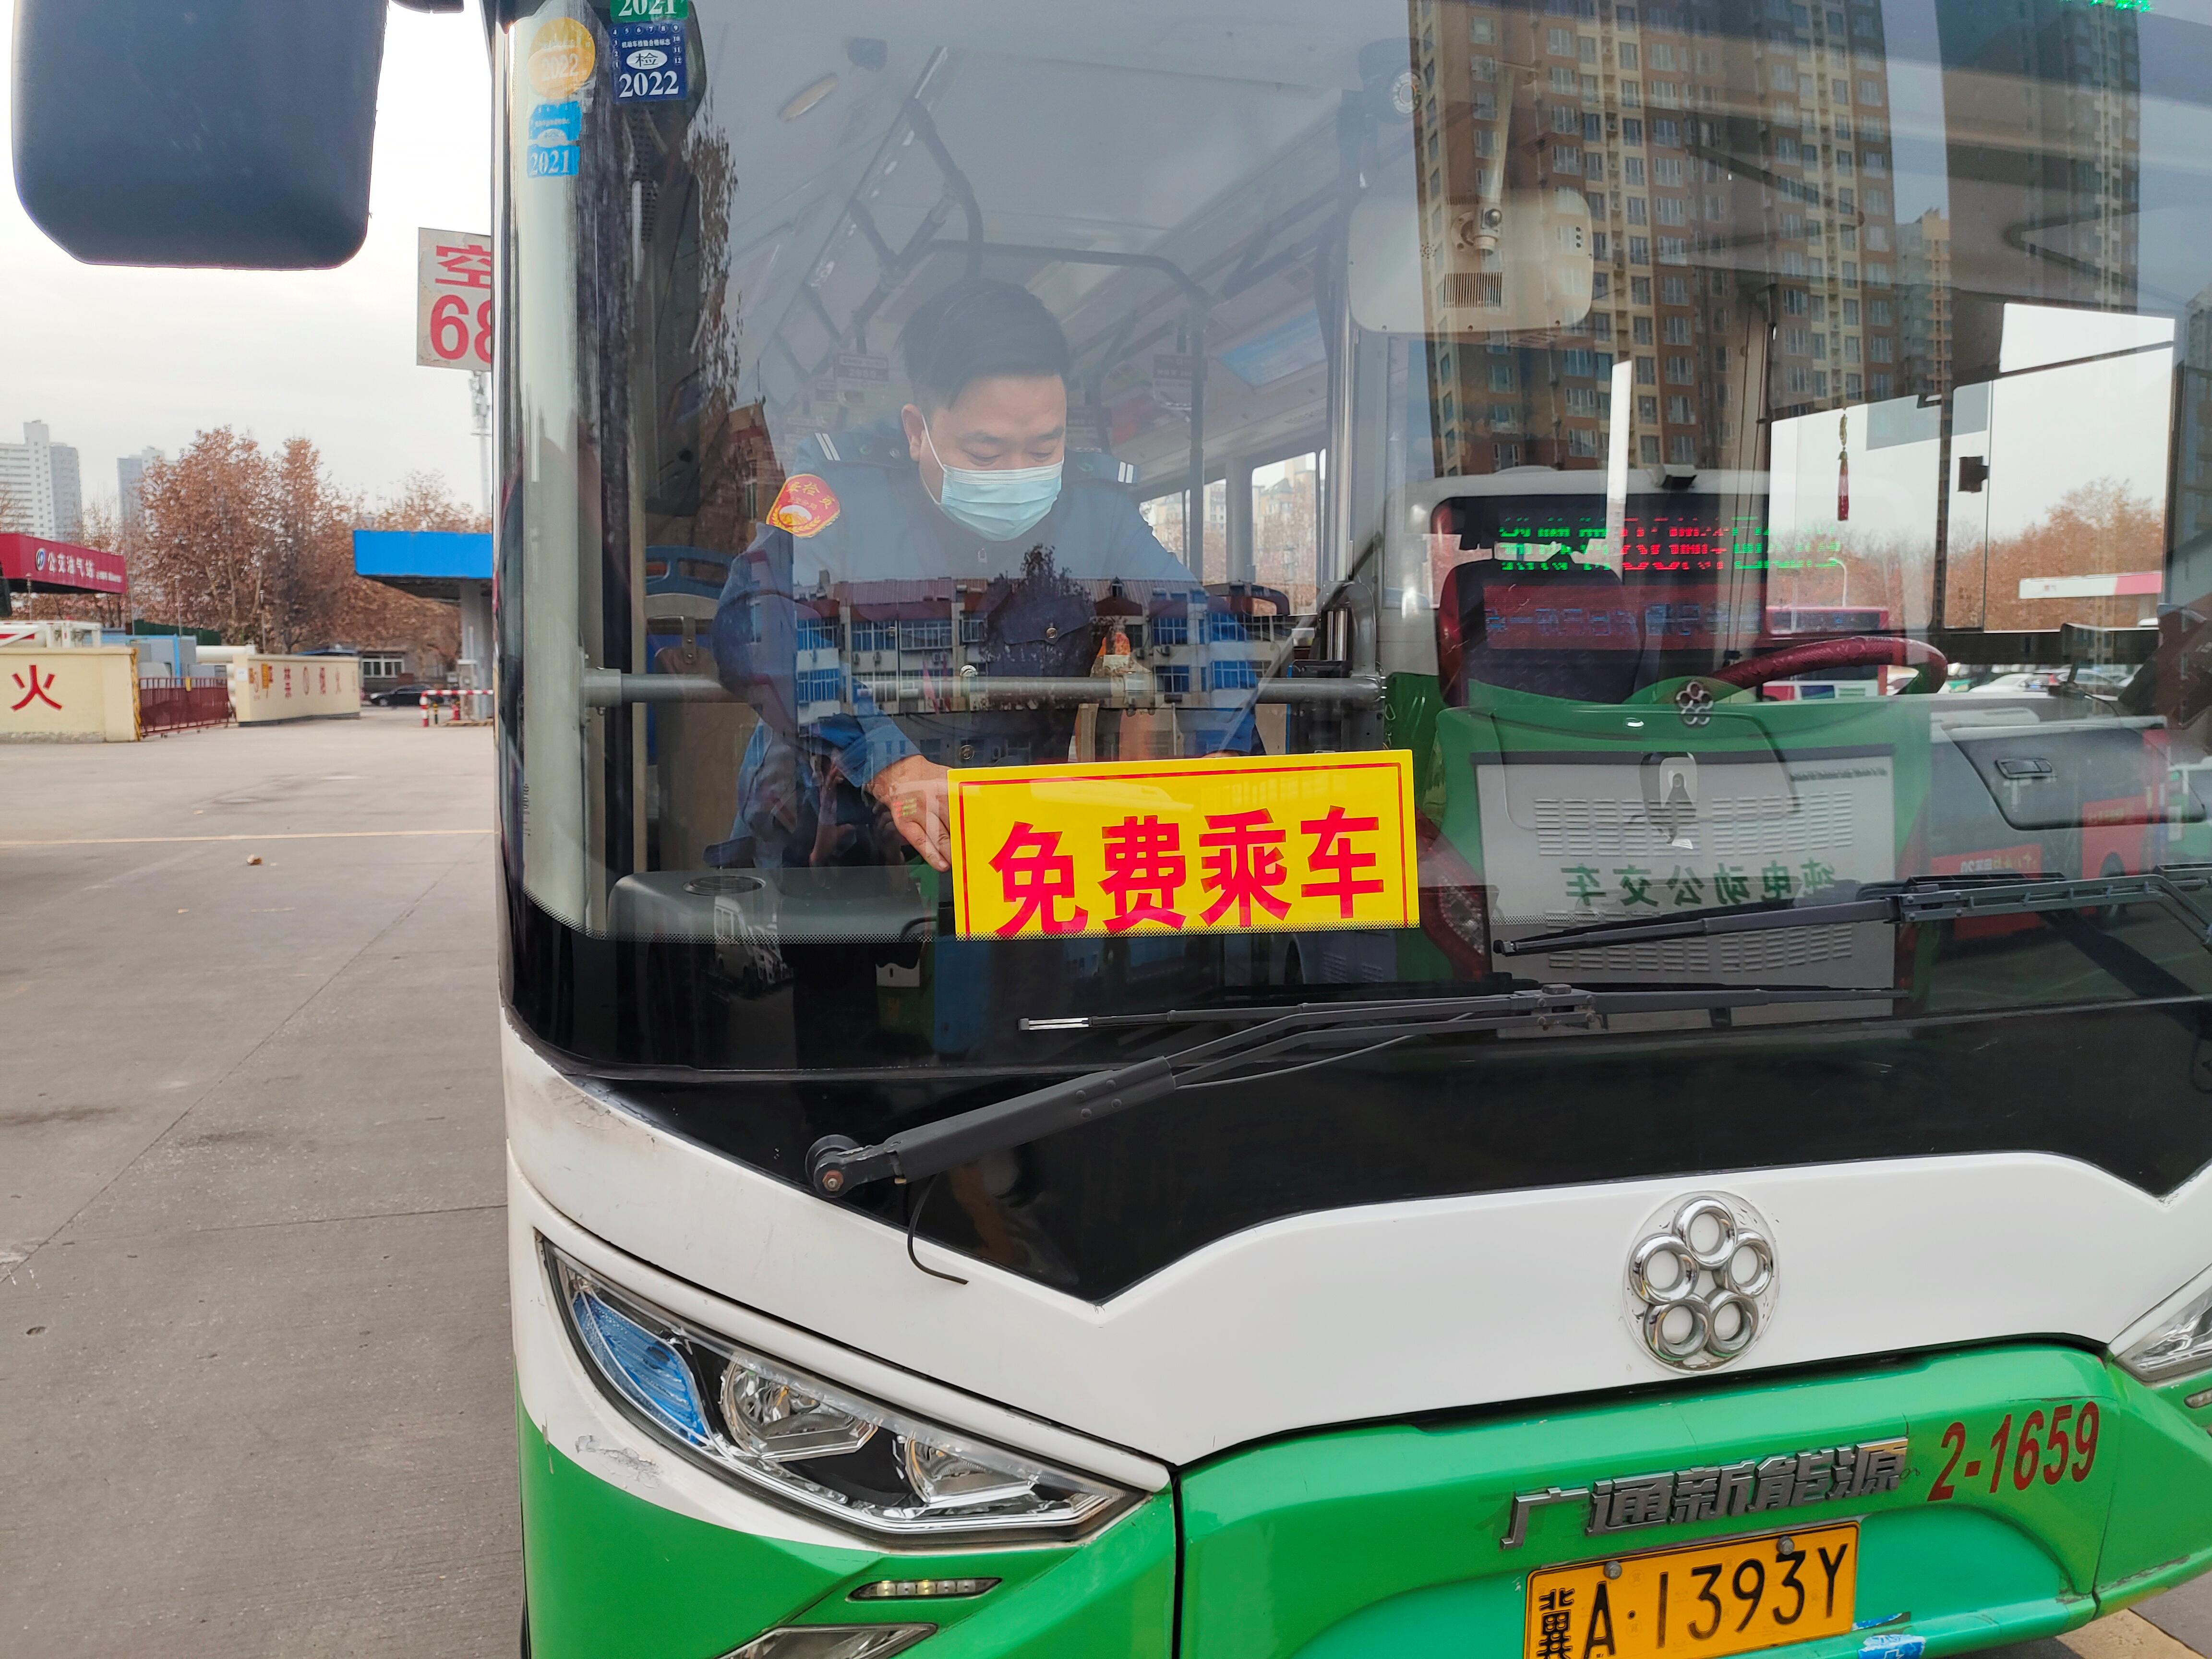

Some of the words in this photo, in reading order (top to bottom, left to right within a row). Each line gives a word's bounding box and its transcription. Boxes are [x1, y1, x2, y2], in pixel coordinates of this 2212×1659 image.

[618, 0, 677, 16] 2021
[541, 53, 579, 82] 2022
[635, 52, 659, 67] 检
[618, 71, 679, 98] 2022
[529, 149, 569, 176] 2021
[11, 664, 63, 712] 火
[989, 805, 1384, 937] 免费乘车
[1927, 1401, 2099, 1502] 2-1659
[1499, 1436, 1908, 1551] 广通新能源
